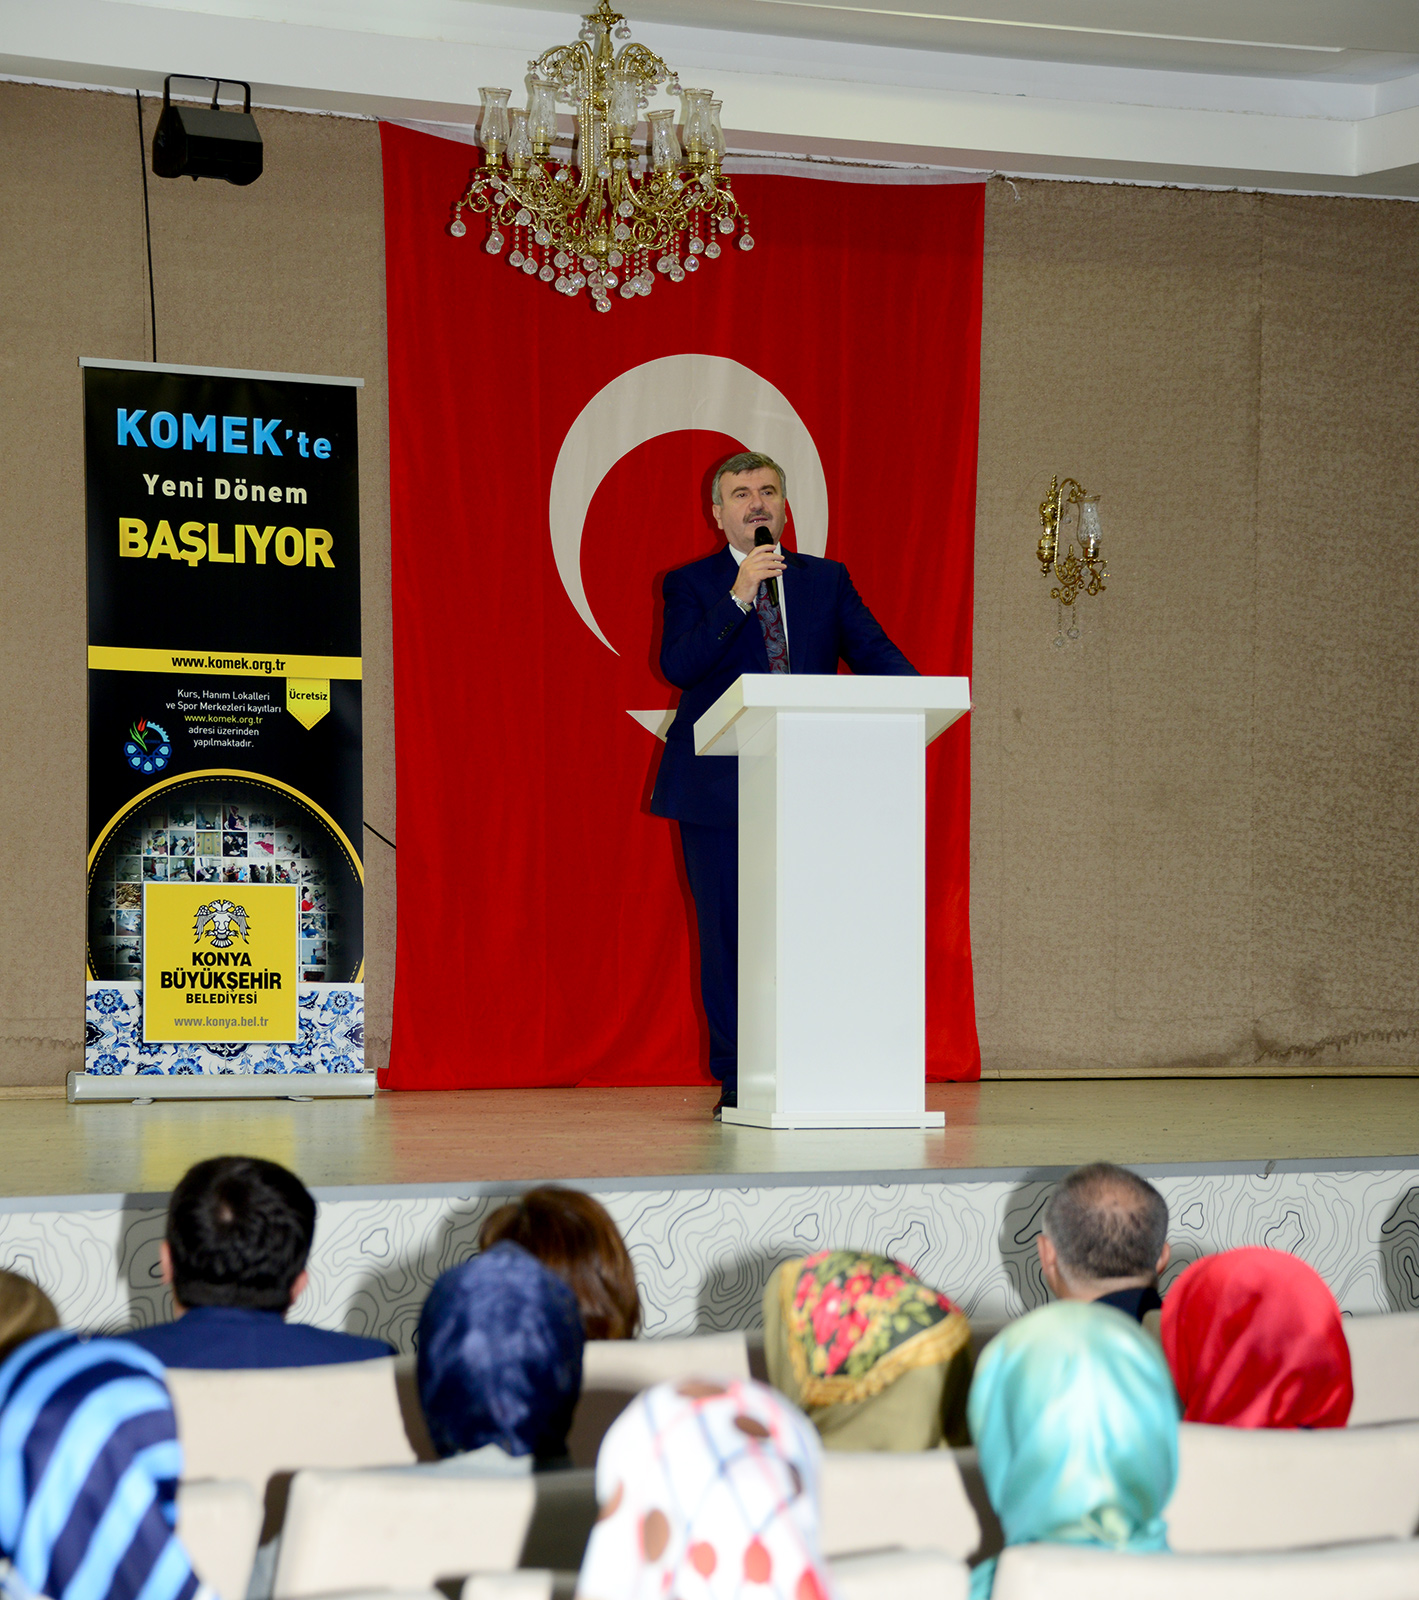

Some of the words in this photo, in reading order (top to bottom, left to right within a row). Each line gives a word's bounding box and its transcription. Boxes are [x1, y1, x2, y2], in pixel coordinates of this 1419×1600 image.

[143, 473, 204, 498] Yeni
[214, 478, 308, 504] Dönem
[118, 517, 336, 568] BAŞLIYOR
[171, 655, 286, 674] www.komek.org.tr
[177, 689, 201, 700] Kurs,
[202, 690, 231, 700] Hanım
[232, 691, 271, 701] Lokalleri
[289, 688, 328, 701] Ücretsiz
[165, 702, 176, 710] ve
[177, 701, 198, 712] Spor
[199, 702, 246, 712] Merkezleri
[247, 704, 282, 714] kayıtları
[184, 713, 264, 726] www.komek.org.tr
[188, 725, 216, 735] adresi
[217, 726, 260, 736] üzerinden
[193, 737, 255, 748] yapılmaktadır.
[192, 951, 252, 967] KONYA
[160, 967, 282, 992] BÜYÜKŞEHİR
[185, 991, 258, 1004] BELEDİYESİ
[174, 1016, 269, 1029] www.konya.bel.tr
